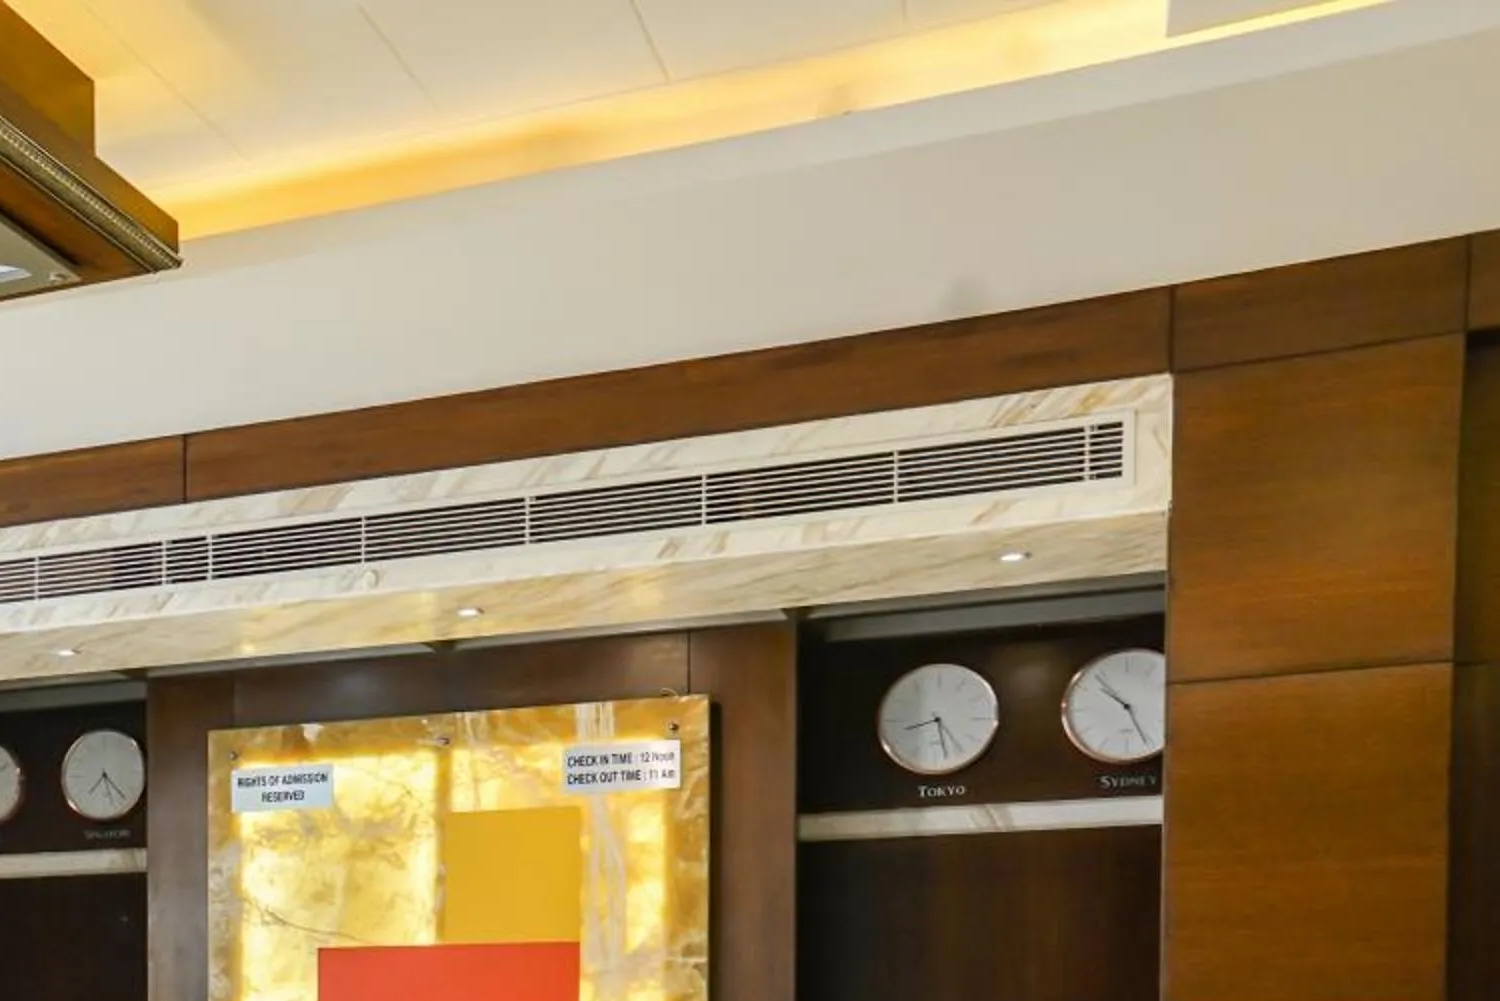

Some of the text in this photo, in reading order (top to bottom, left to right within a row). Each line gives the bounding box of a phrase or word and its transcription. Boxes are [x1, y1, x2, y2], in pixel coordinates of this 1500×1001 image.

[567, 755, 598, 767] CHECK
[599, 754, 609, 764] IN
[612, 752, 632, 764] TIME
[640, 752, 650, 762] 12
[238, 773, 328, 787] RIGHTS OF ADMISSION
[567, 773, 598, 785] CHECK
[600, 771, 618, 783] OUT
[621, 769, 641, 781] TIME
[261, 790, 305, 803] RESERVED
